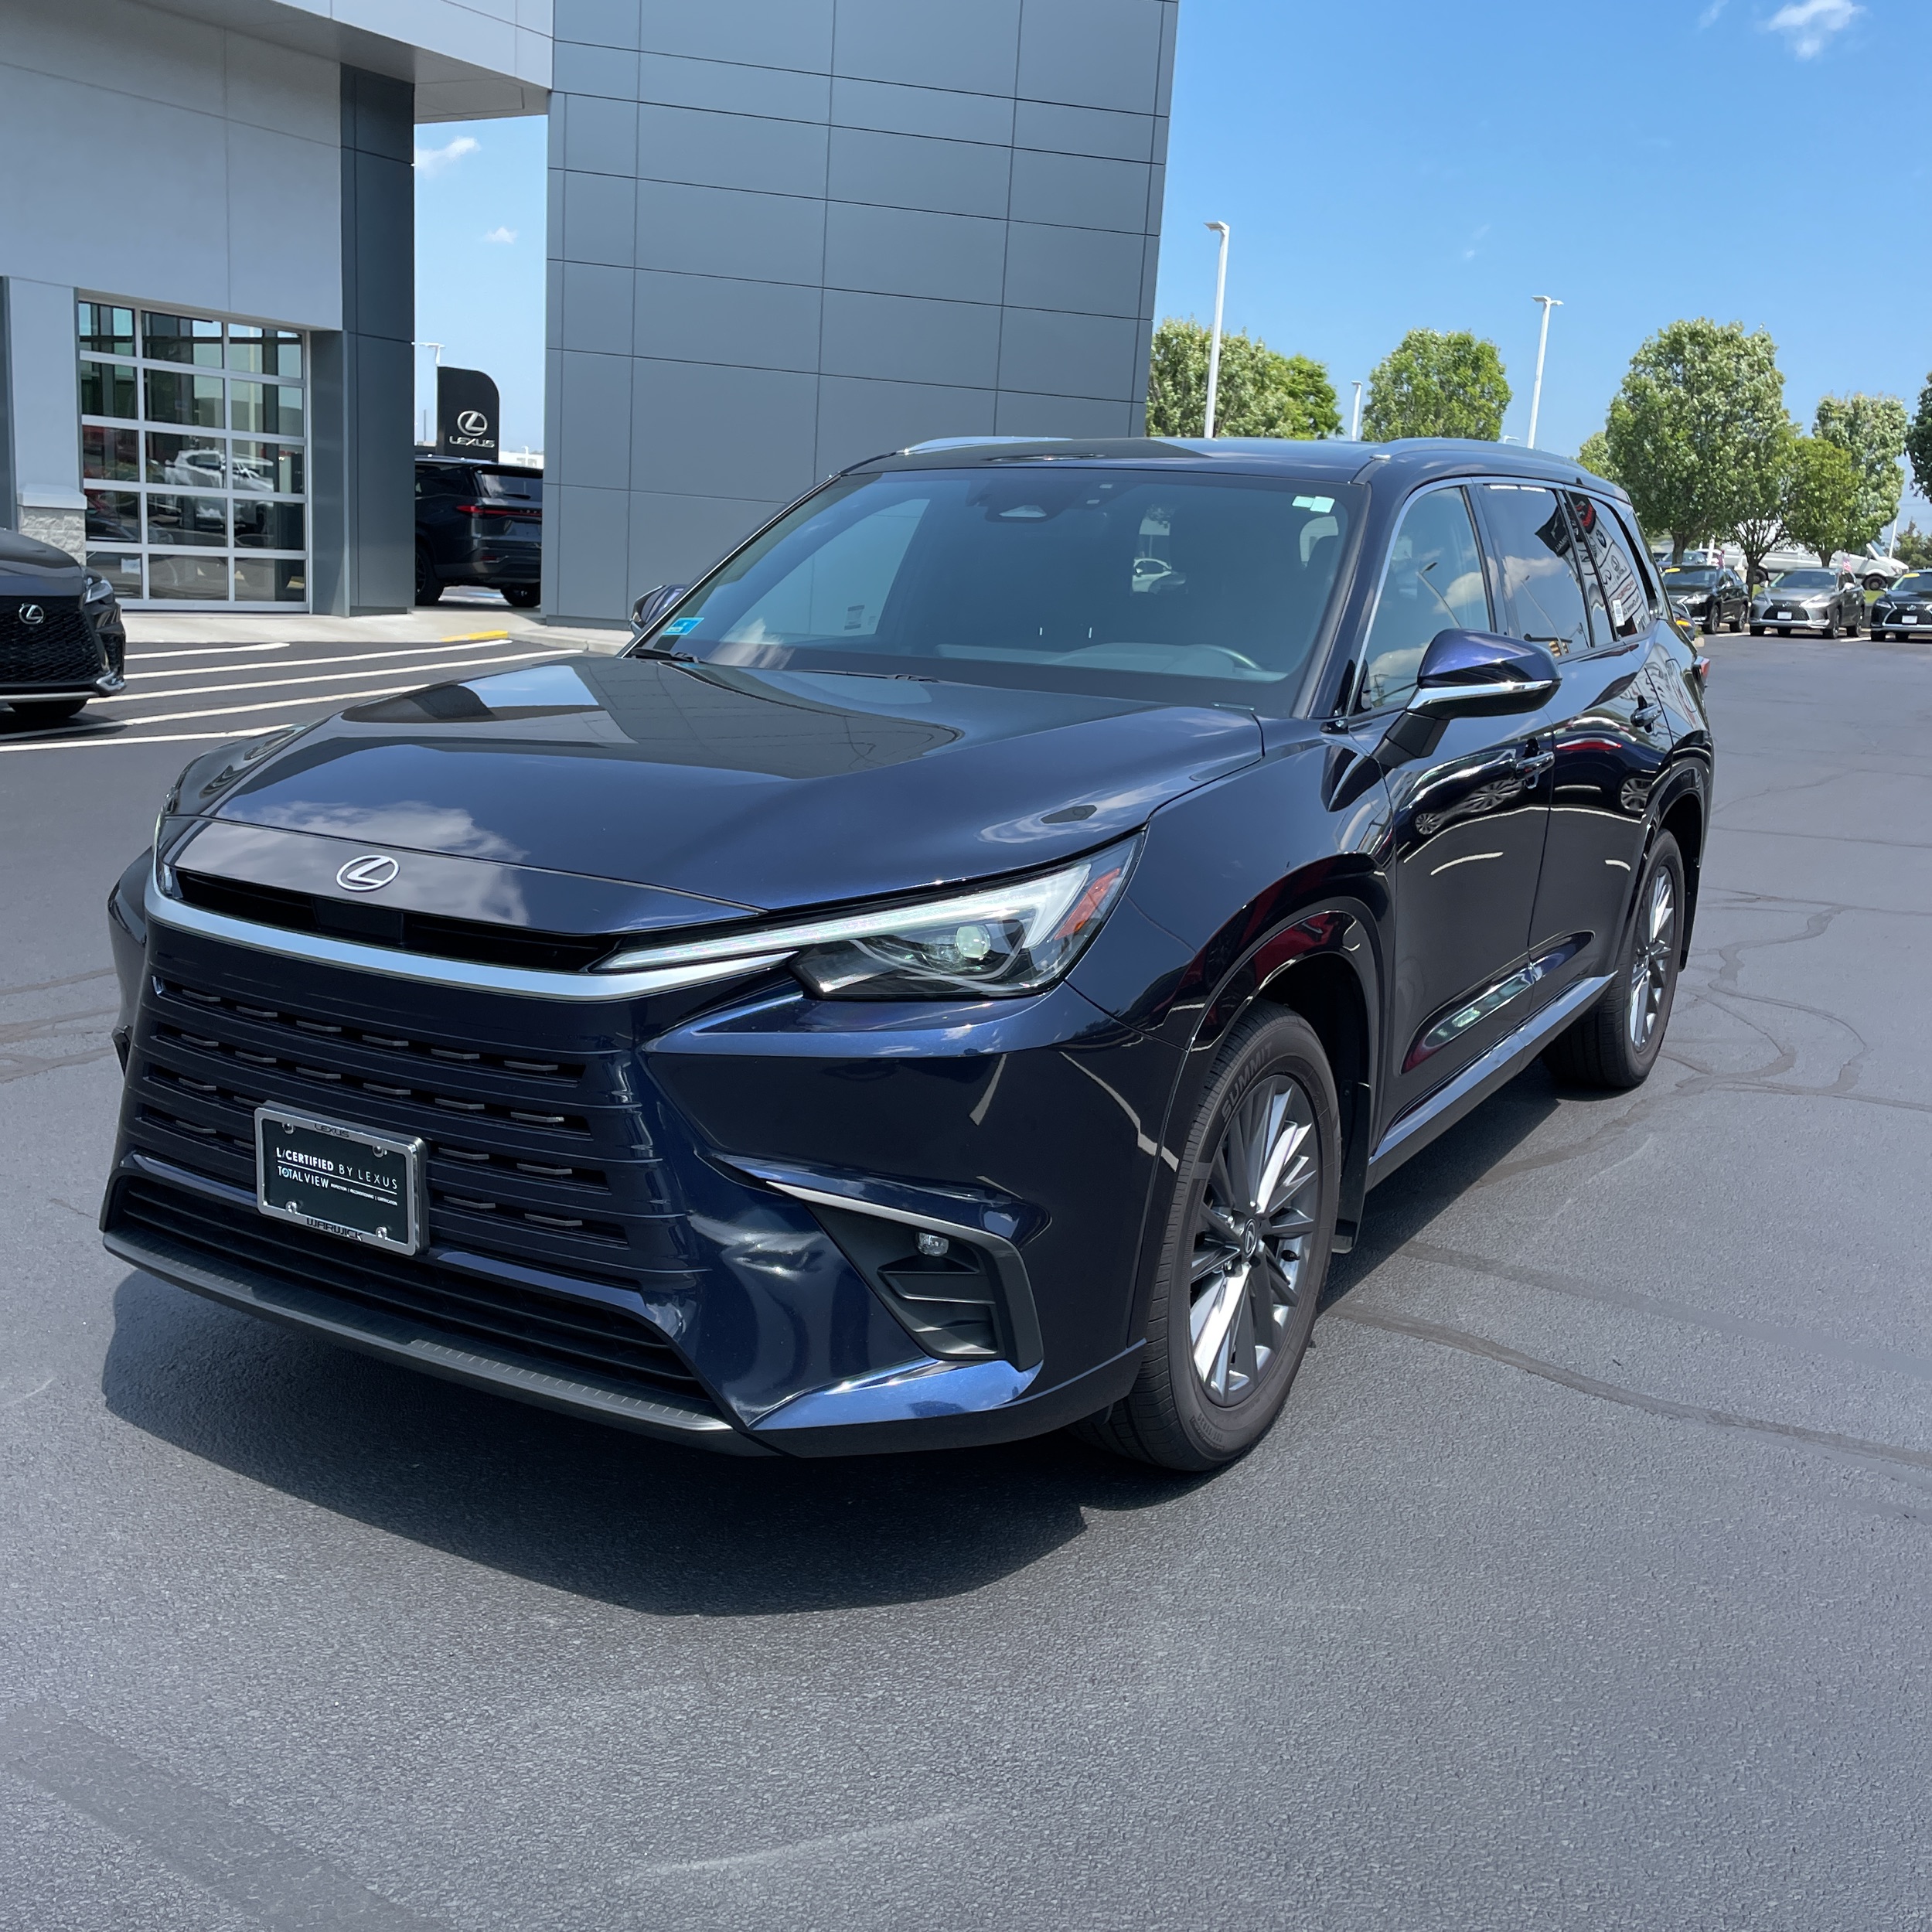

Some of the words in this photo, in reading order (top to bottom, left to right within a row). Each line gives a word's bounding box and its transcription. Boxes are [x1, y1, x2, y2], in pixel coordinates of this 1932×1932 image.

[449, 435, 495, 448] LEXUS
[1222, 1041, 1273, 1123] SUMMIT
[314, 1123, 349, 1137] LEXUS
[339, 1164, 353, 1177] BY
[358, 1169, 397, 1190] LEXUS
[306, 1217, 363, 1242] WARWICK
